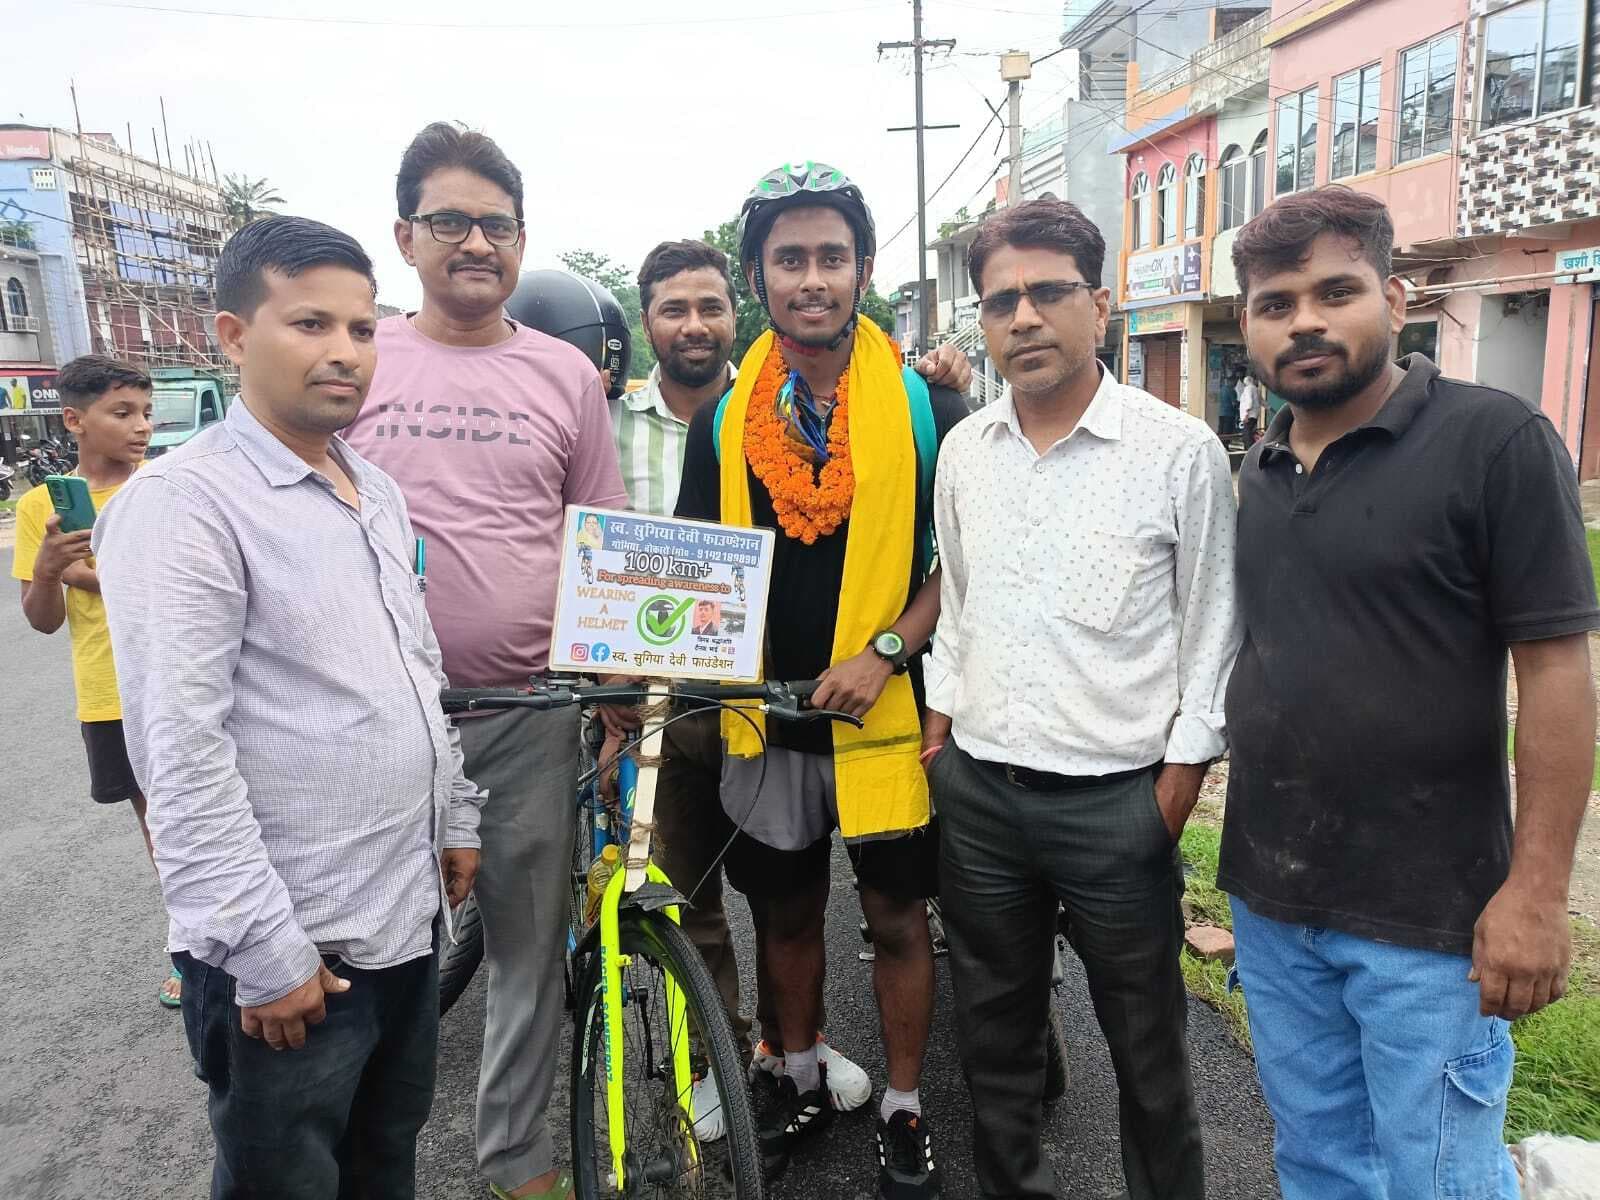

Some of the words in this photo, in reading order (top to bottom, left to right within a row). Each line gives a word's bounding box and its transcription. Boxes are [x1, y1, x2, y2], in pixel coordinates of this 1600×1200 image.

[376, 400, 531, 446] INSIDE
[678, 526, 699, 544] देवी
[625, 551, 664, 574] 100
[666, 554, 713, 578] km+
[597, 570, 617, 583] For
[617, 573, 666, 589] spreading
[666, 579, 719, 593] awareness
[720, 583, 732, 595] to
[576, 585, 636, 602] WEARING
[600, 604, 609, 614] A
[577, 615, 629, 631] HELMET
[612, 651, 628, 663] स्व.
[634, 651, 663, 666] सुगिया
[669, 652, 686, 666] देवी
